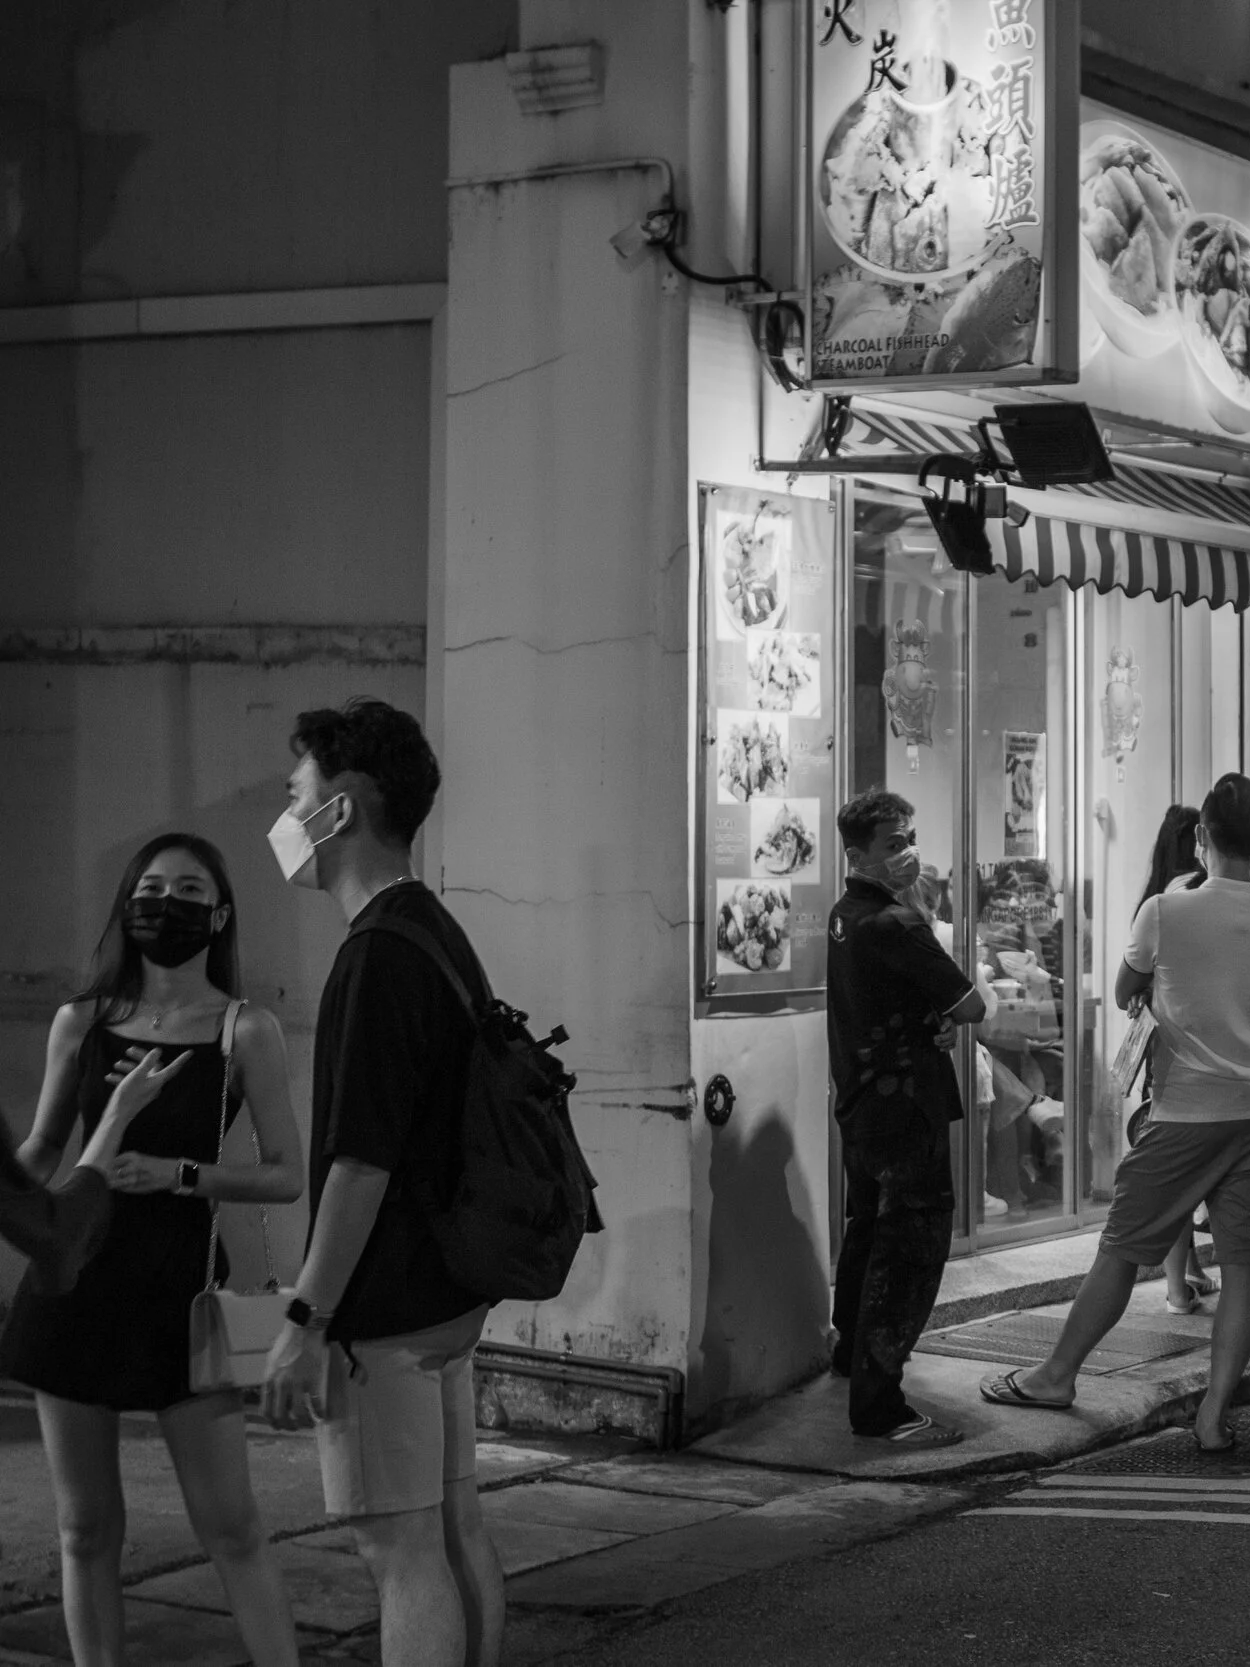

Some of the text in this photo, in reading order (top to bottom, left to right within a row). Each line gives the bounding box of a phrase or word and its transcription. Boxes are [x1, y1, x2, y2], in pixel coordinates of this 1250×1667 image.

[816, 333, 950, 355] CHARCOAL FISHHEAD
[816, 355, 890, 371] STEAMBOAT
